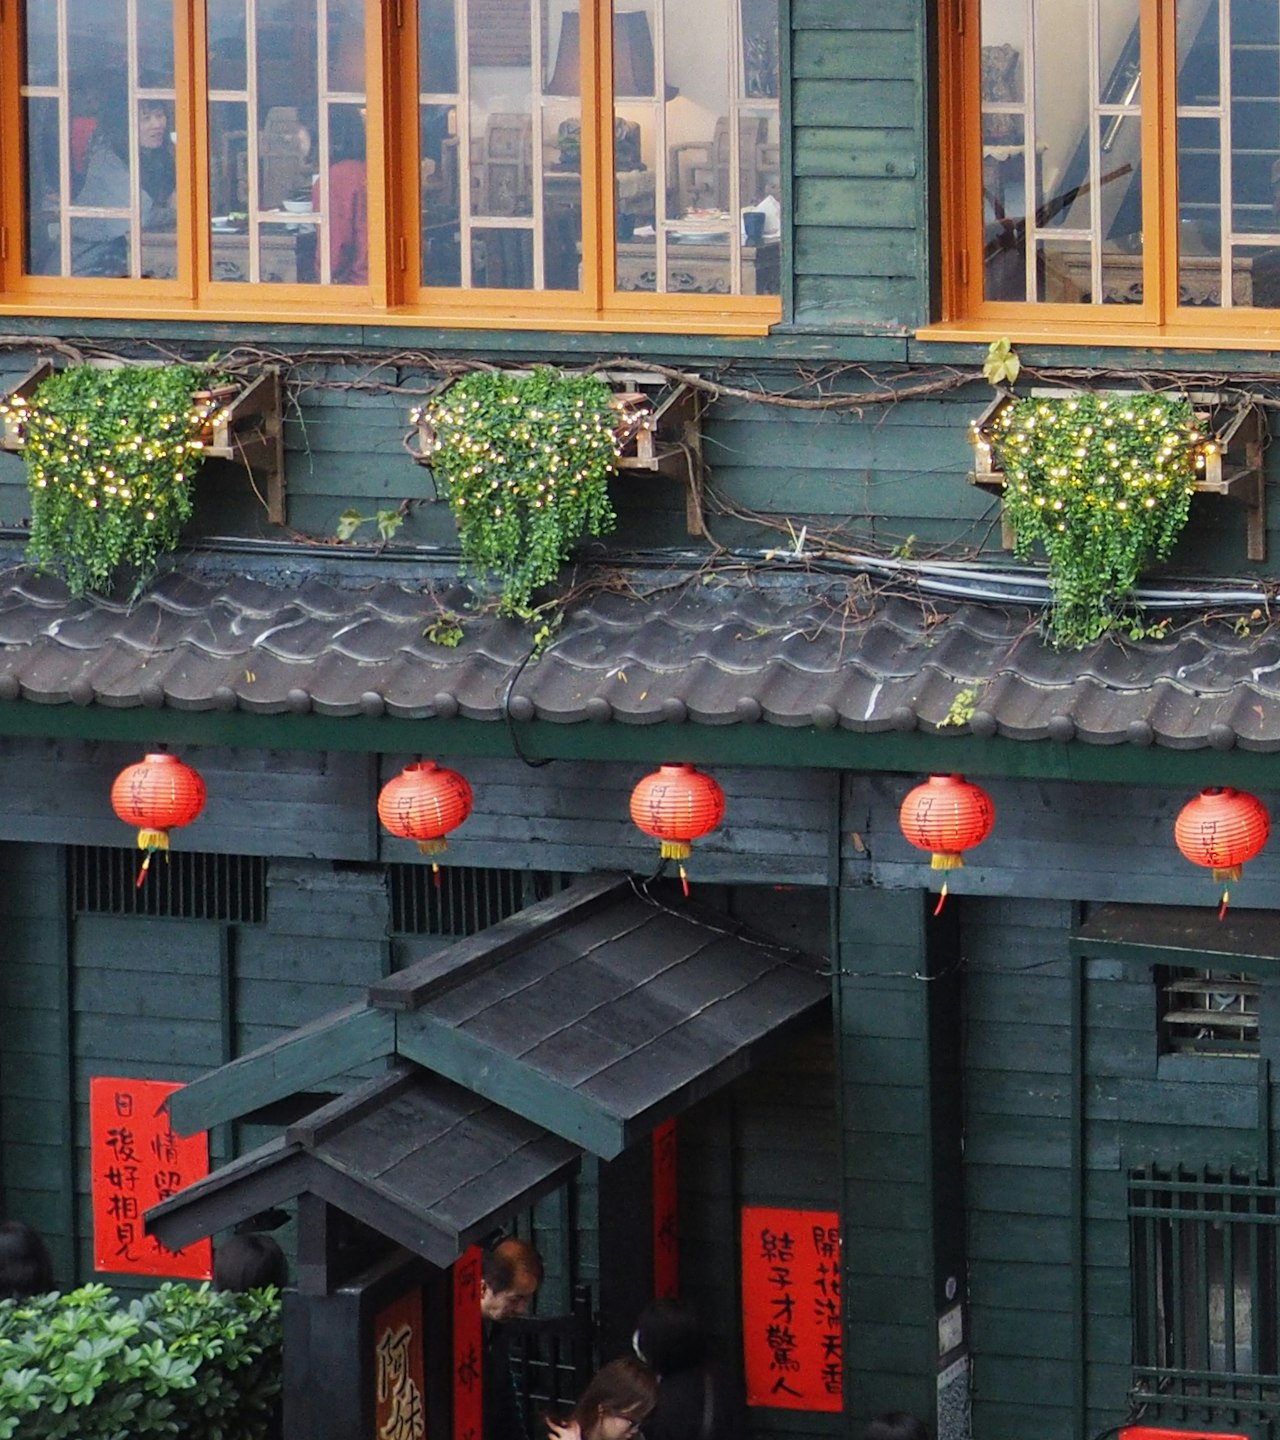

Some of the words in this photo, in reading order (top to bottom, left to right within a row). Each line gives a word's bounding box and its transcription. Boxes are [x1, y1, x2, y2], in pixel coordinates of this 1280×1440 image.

[104, 1092, 142, 1262] 日後好相見
[760, 1227, 804, 1398] 結子才驚人
